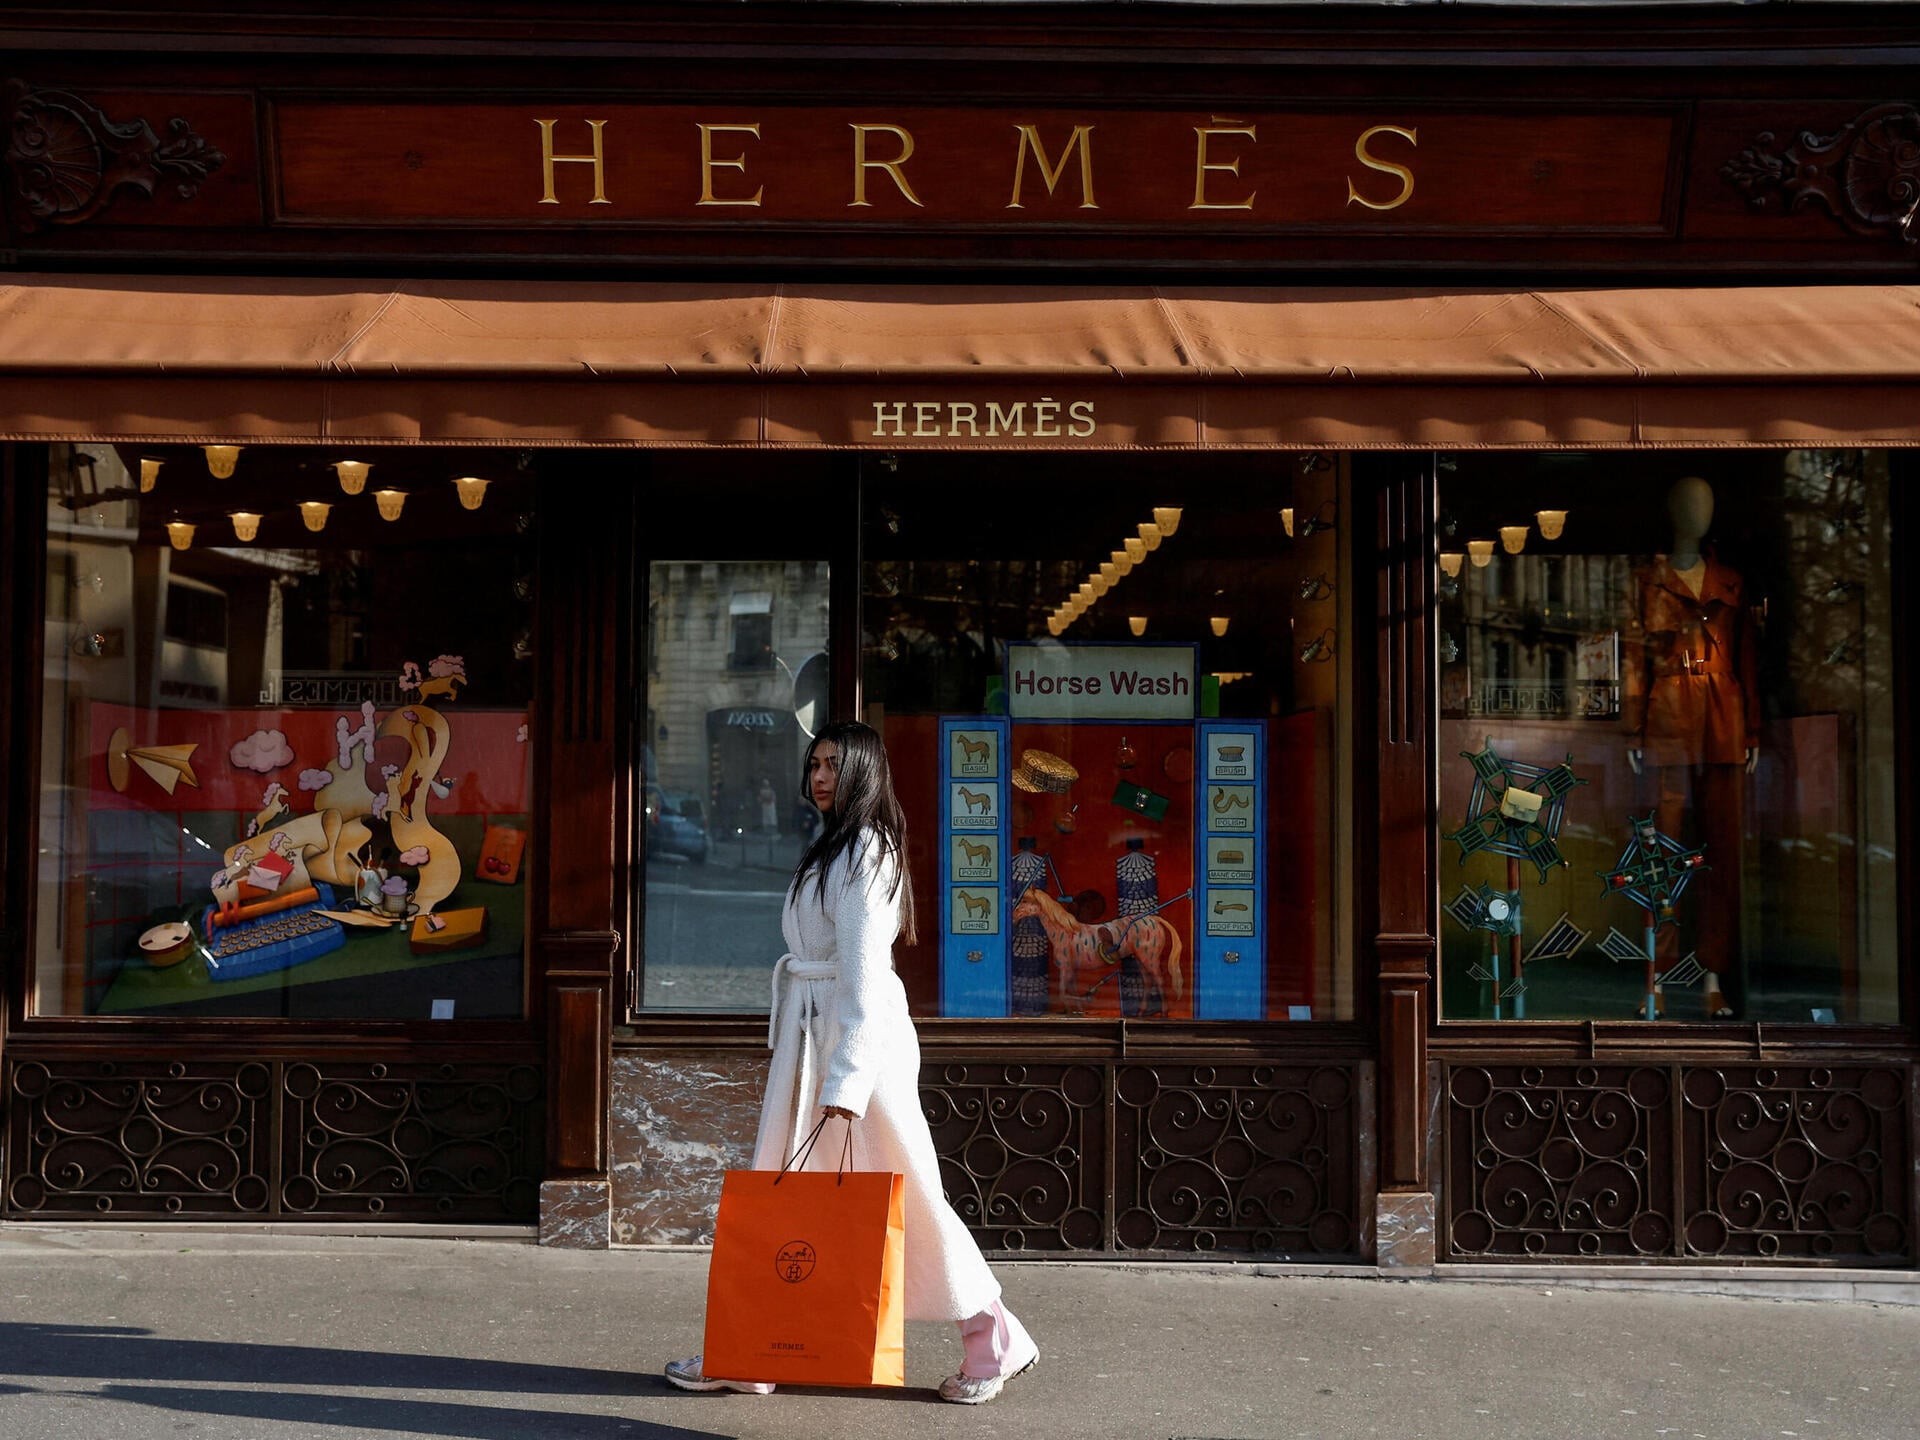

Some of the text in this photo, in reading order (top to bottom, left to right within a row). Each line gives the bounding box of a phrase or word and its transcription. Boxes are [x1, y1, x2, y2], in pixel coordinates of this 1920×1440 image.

[533, 115, 1419, 211] HERMÈS
[872, 397, 1097, 438] HERMÈS
[1015, 669, 1189, 696] Horse Wash
[955, 817, 994, 825] ELEGANCE
